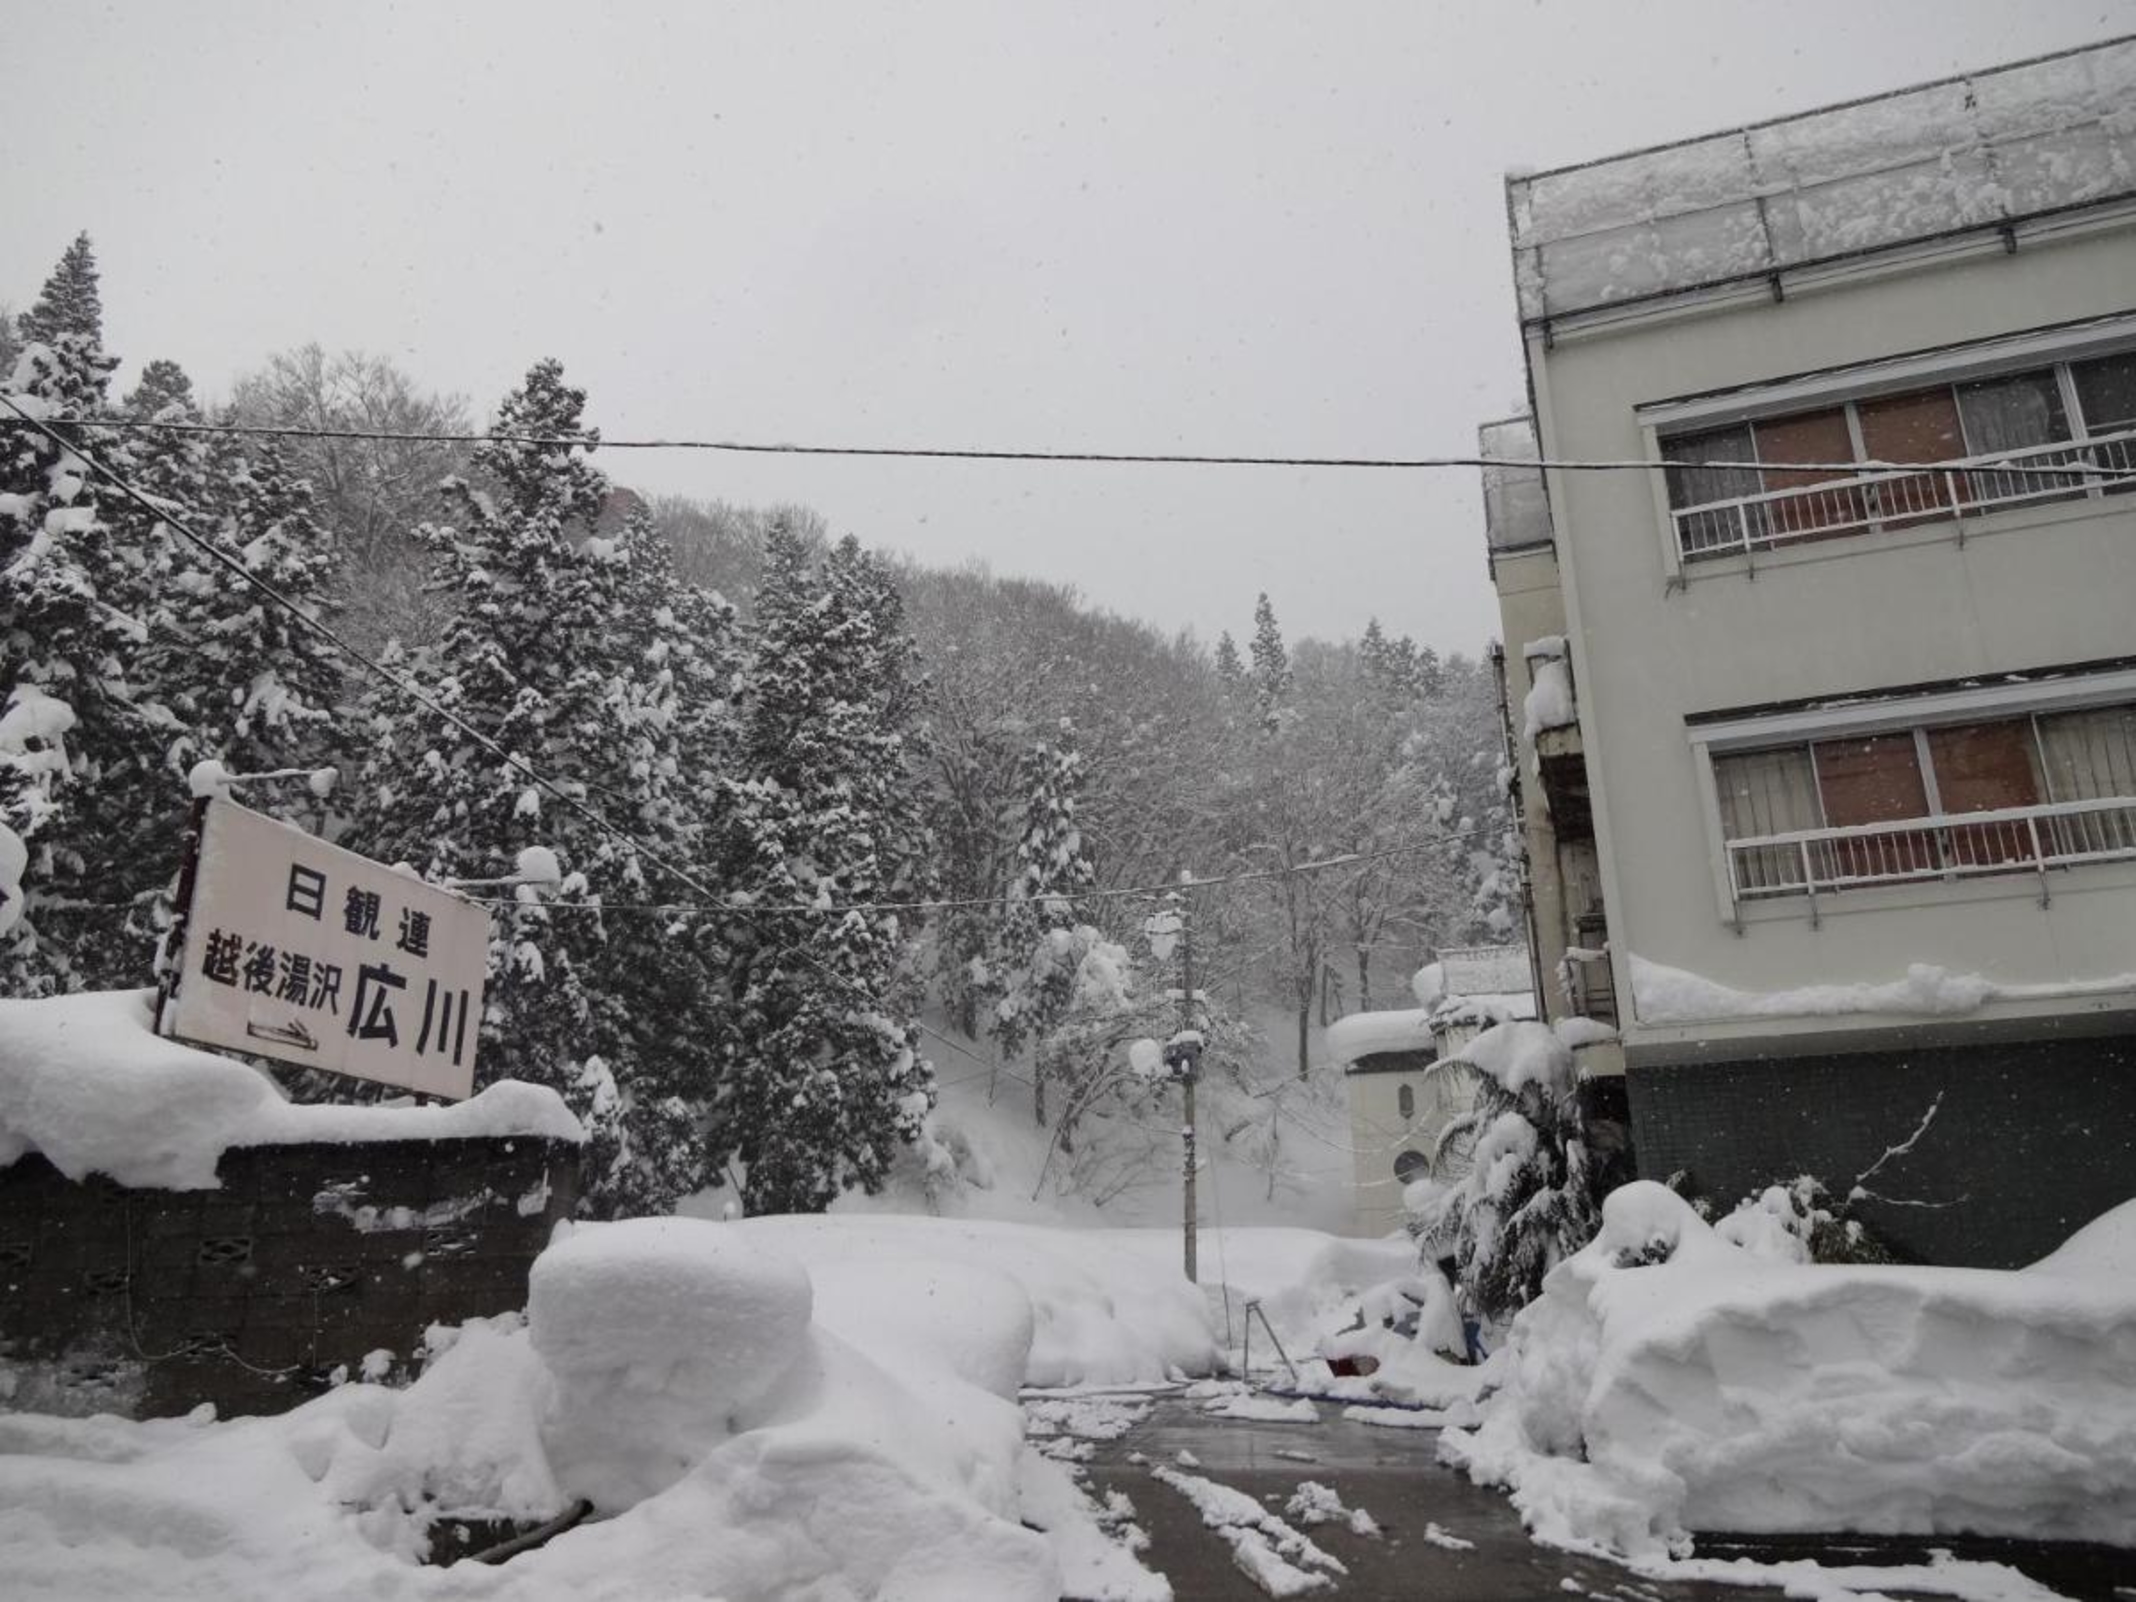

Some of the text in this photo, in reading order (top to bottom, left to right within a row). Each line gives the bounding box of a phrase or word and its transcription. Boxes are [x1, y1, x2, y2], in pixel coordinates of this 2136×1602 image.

[287, 863, 431, 958] 日観連
[202, 928, 469, 1066] 越後湯沢 広川
